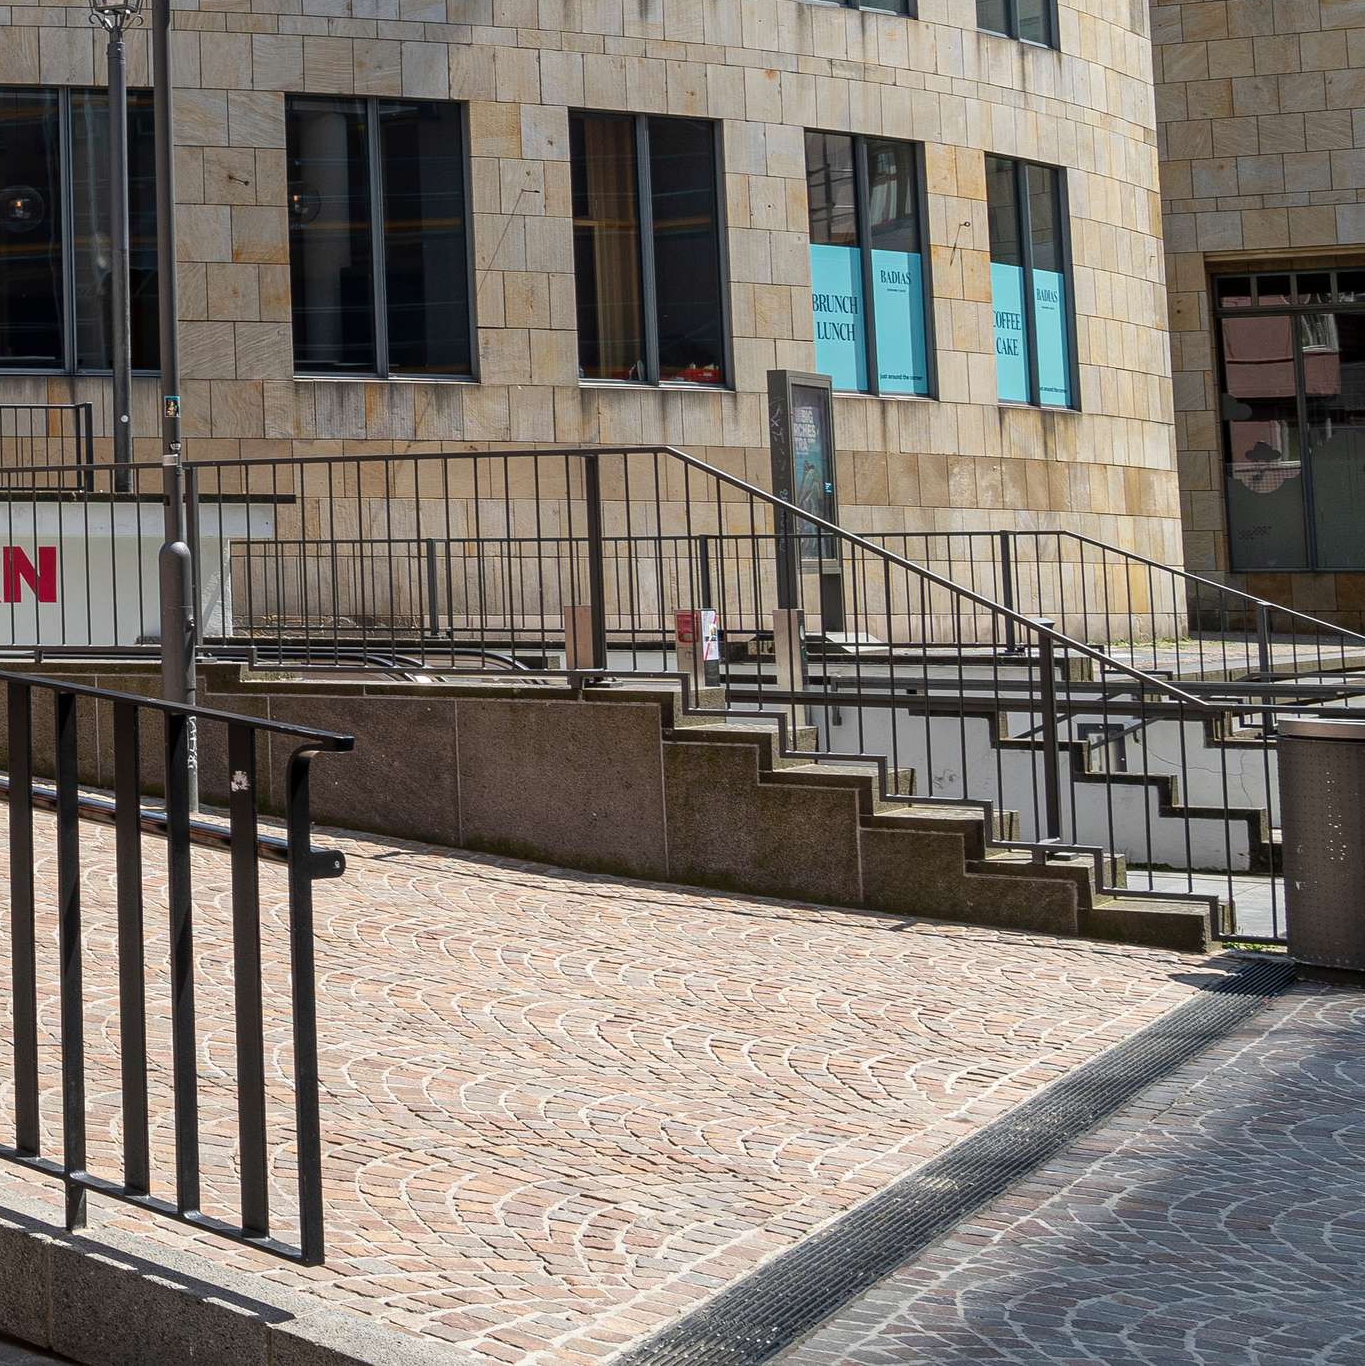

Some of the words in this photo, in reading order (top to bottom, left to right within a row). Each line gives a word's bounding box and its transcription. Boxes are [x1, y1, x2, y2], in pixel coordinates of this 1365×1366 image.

[880, 269, 912, 286] BADIAS
[812, 293, 859, 315] BRUNCH
[816, 320, 856, 342] LUNCH
[995, 336, 1020, 356] CAKE
